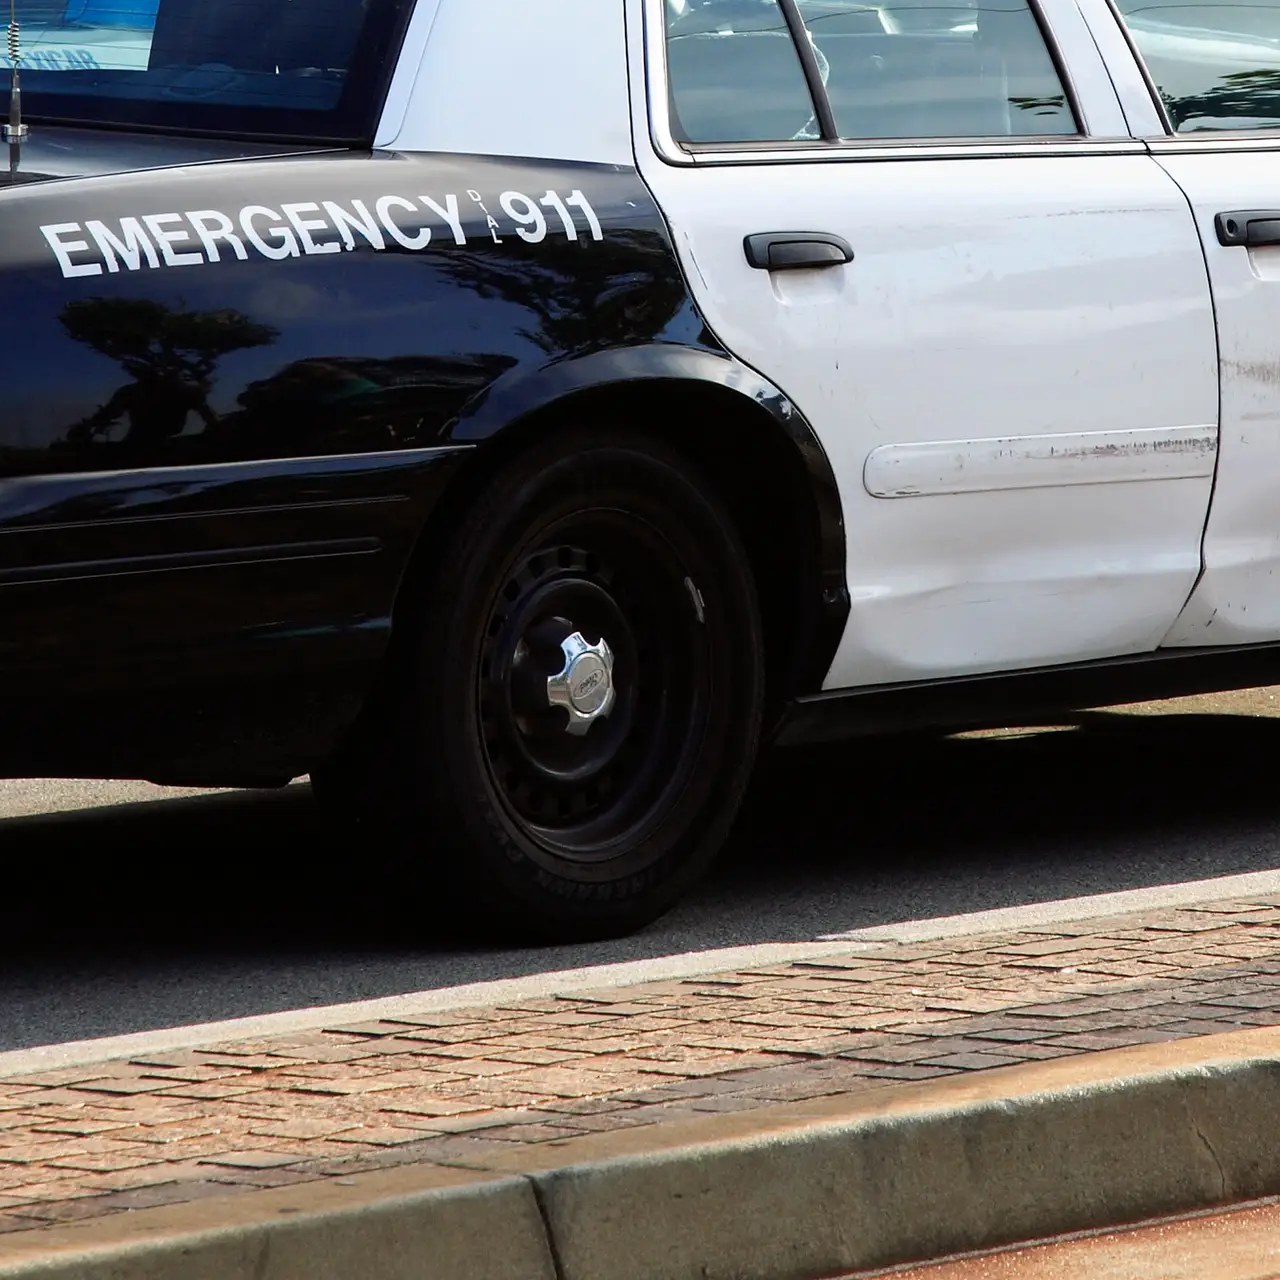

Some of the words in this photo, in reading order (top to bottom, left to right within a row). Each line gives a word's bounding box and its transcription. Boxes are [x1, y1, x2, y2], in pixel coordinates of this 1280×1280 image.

[39, 193, 467, 279] EMERGENCY
[466, 189, 503, 244] DIAL
[499, 190, 604, 244] 911
